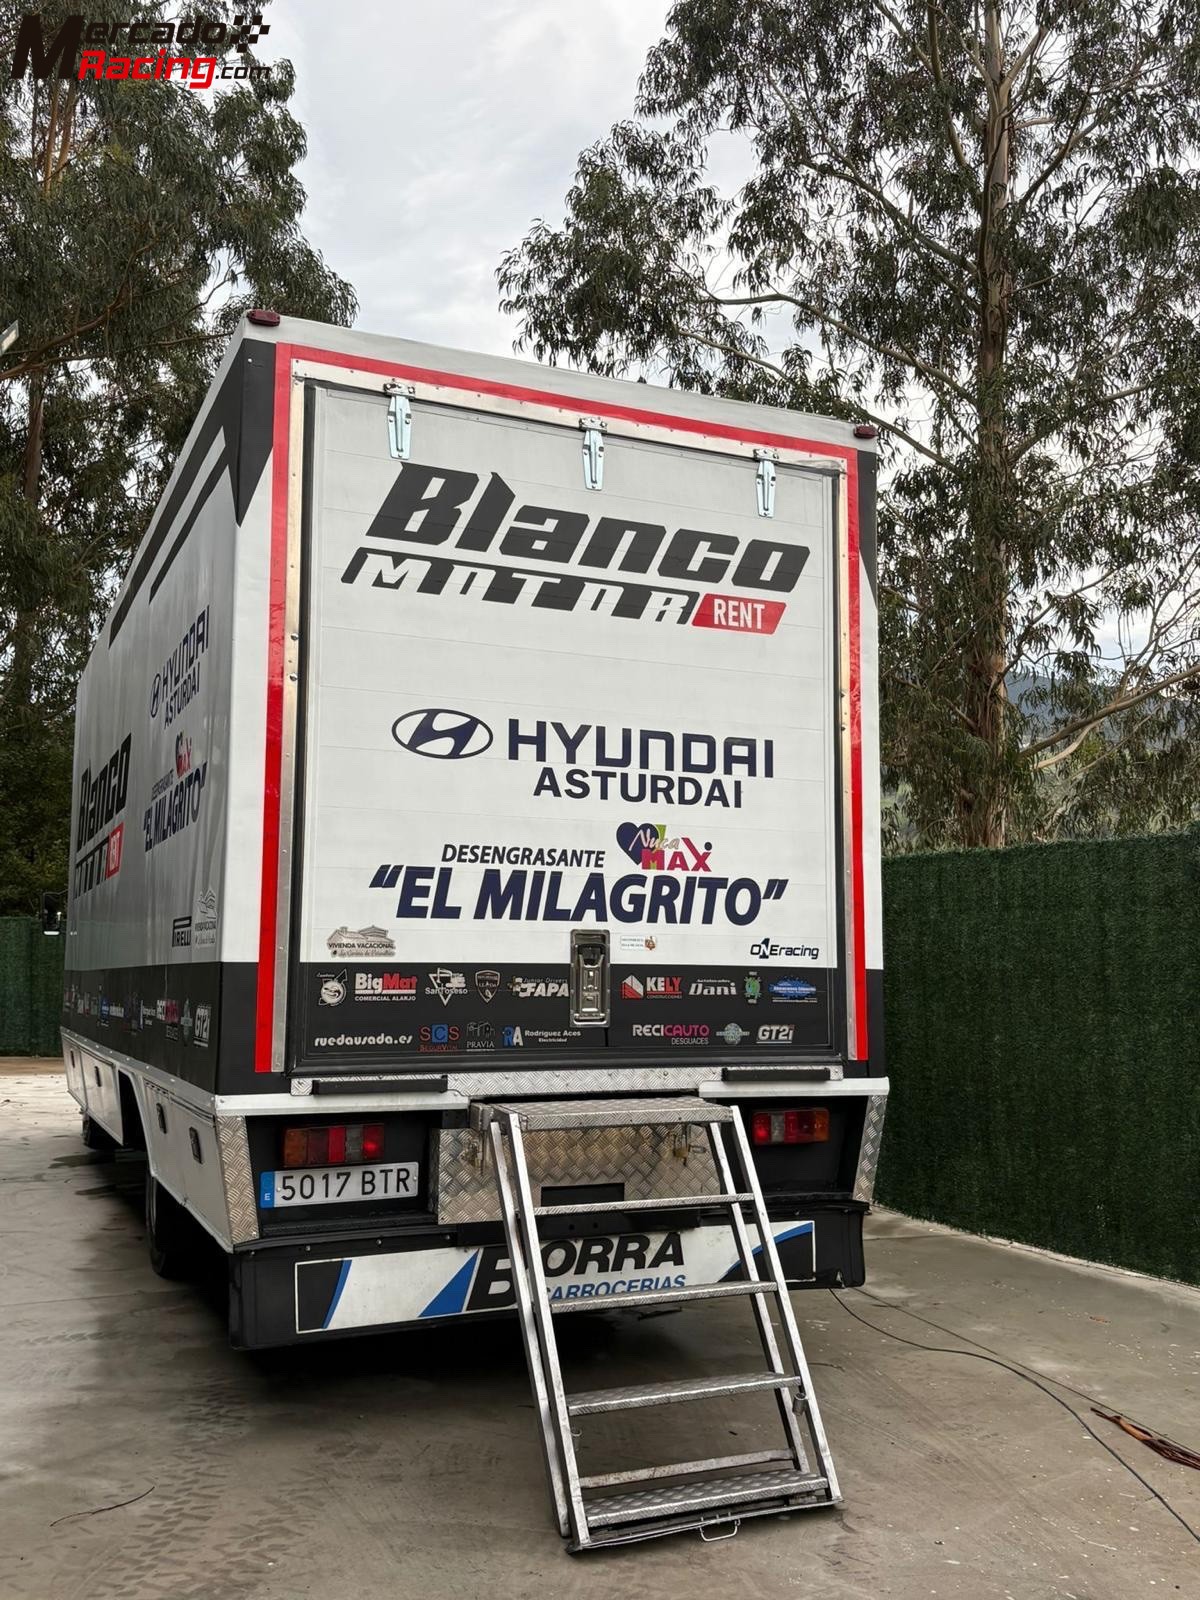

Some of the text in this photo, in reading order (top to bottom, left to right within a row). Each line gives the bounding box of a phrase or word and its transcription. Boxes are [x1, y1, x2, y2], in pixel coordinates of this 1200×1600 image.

[365, 462, 810, 593] Blanco
[341, 547, 768, 630] MOTOR RENT
[162, 604, 209, 703] HYUNDAI
[164, 661, 200, 730] ASTURDAI
[508, 718, 774, 778] HYUNDAI
[533, 767, 742, 808] ASTURDAI
[441, 844, 606, 868] DESENGRASANTE
[369, 864, 789, 926] “EL MILAGRITO”
[355, 972, 418, 994] BigMat
[646, 977, 682, 992] KELY
[688, 982, 738, 996] Dani
[314, 1033, 413, 1047] ruedausada.es
[420, 1025, 460, 1042] SCS
[503, 1026, 524, 1047] RA
[562, 1029, 582, 1037] Aces
[632, 1024, 710, 1037] RECICAUTO
[757, 1025, 795, 1041] GT2i
[466, 1040, 496, 1049] PRAVIA
[671, 1037, 710, 1046] DESGUACES
[281, 1167, 411, 1201] 5017 BTR
[264, 1192, 271, 1201] E
[546, 1274, 687, 1300] ARROCERIAS
